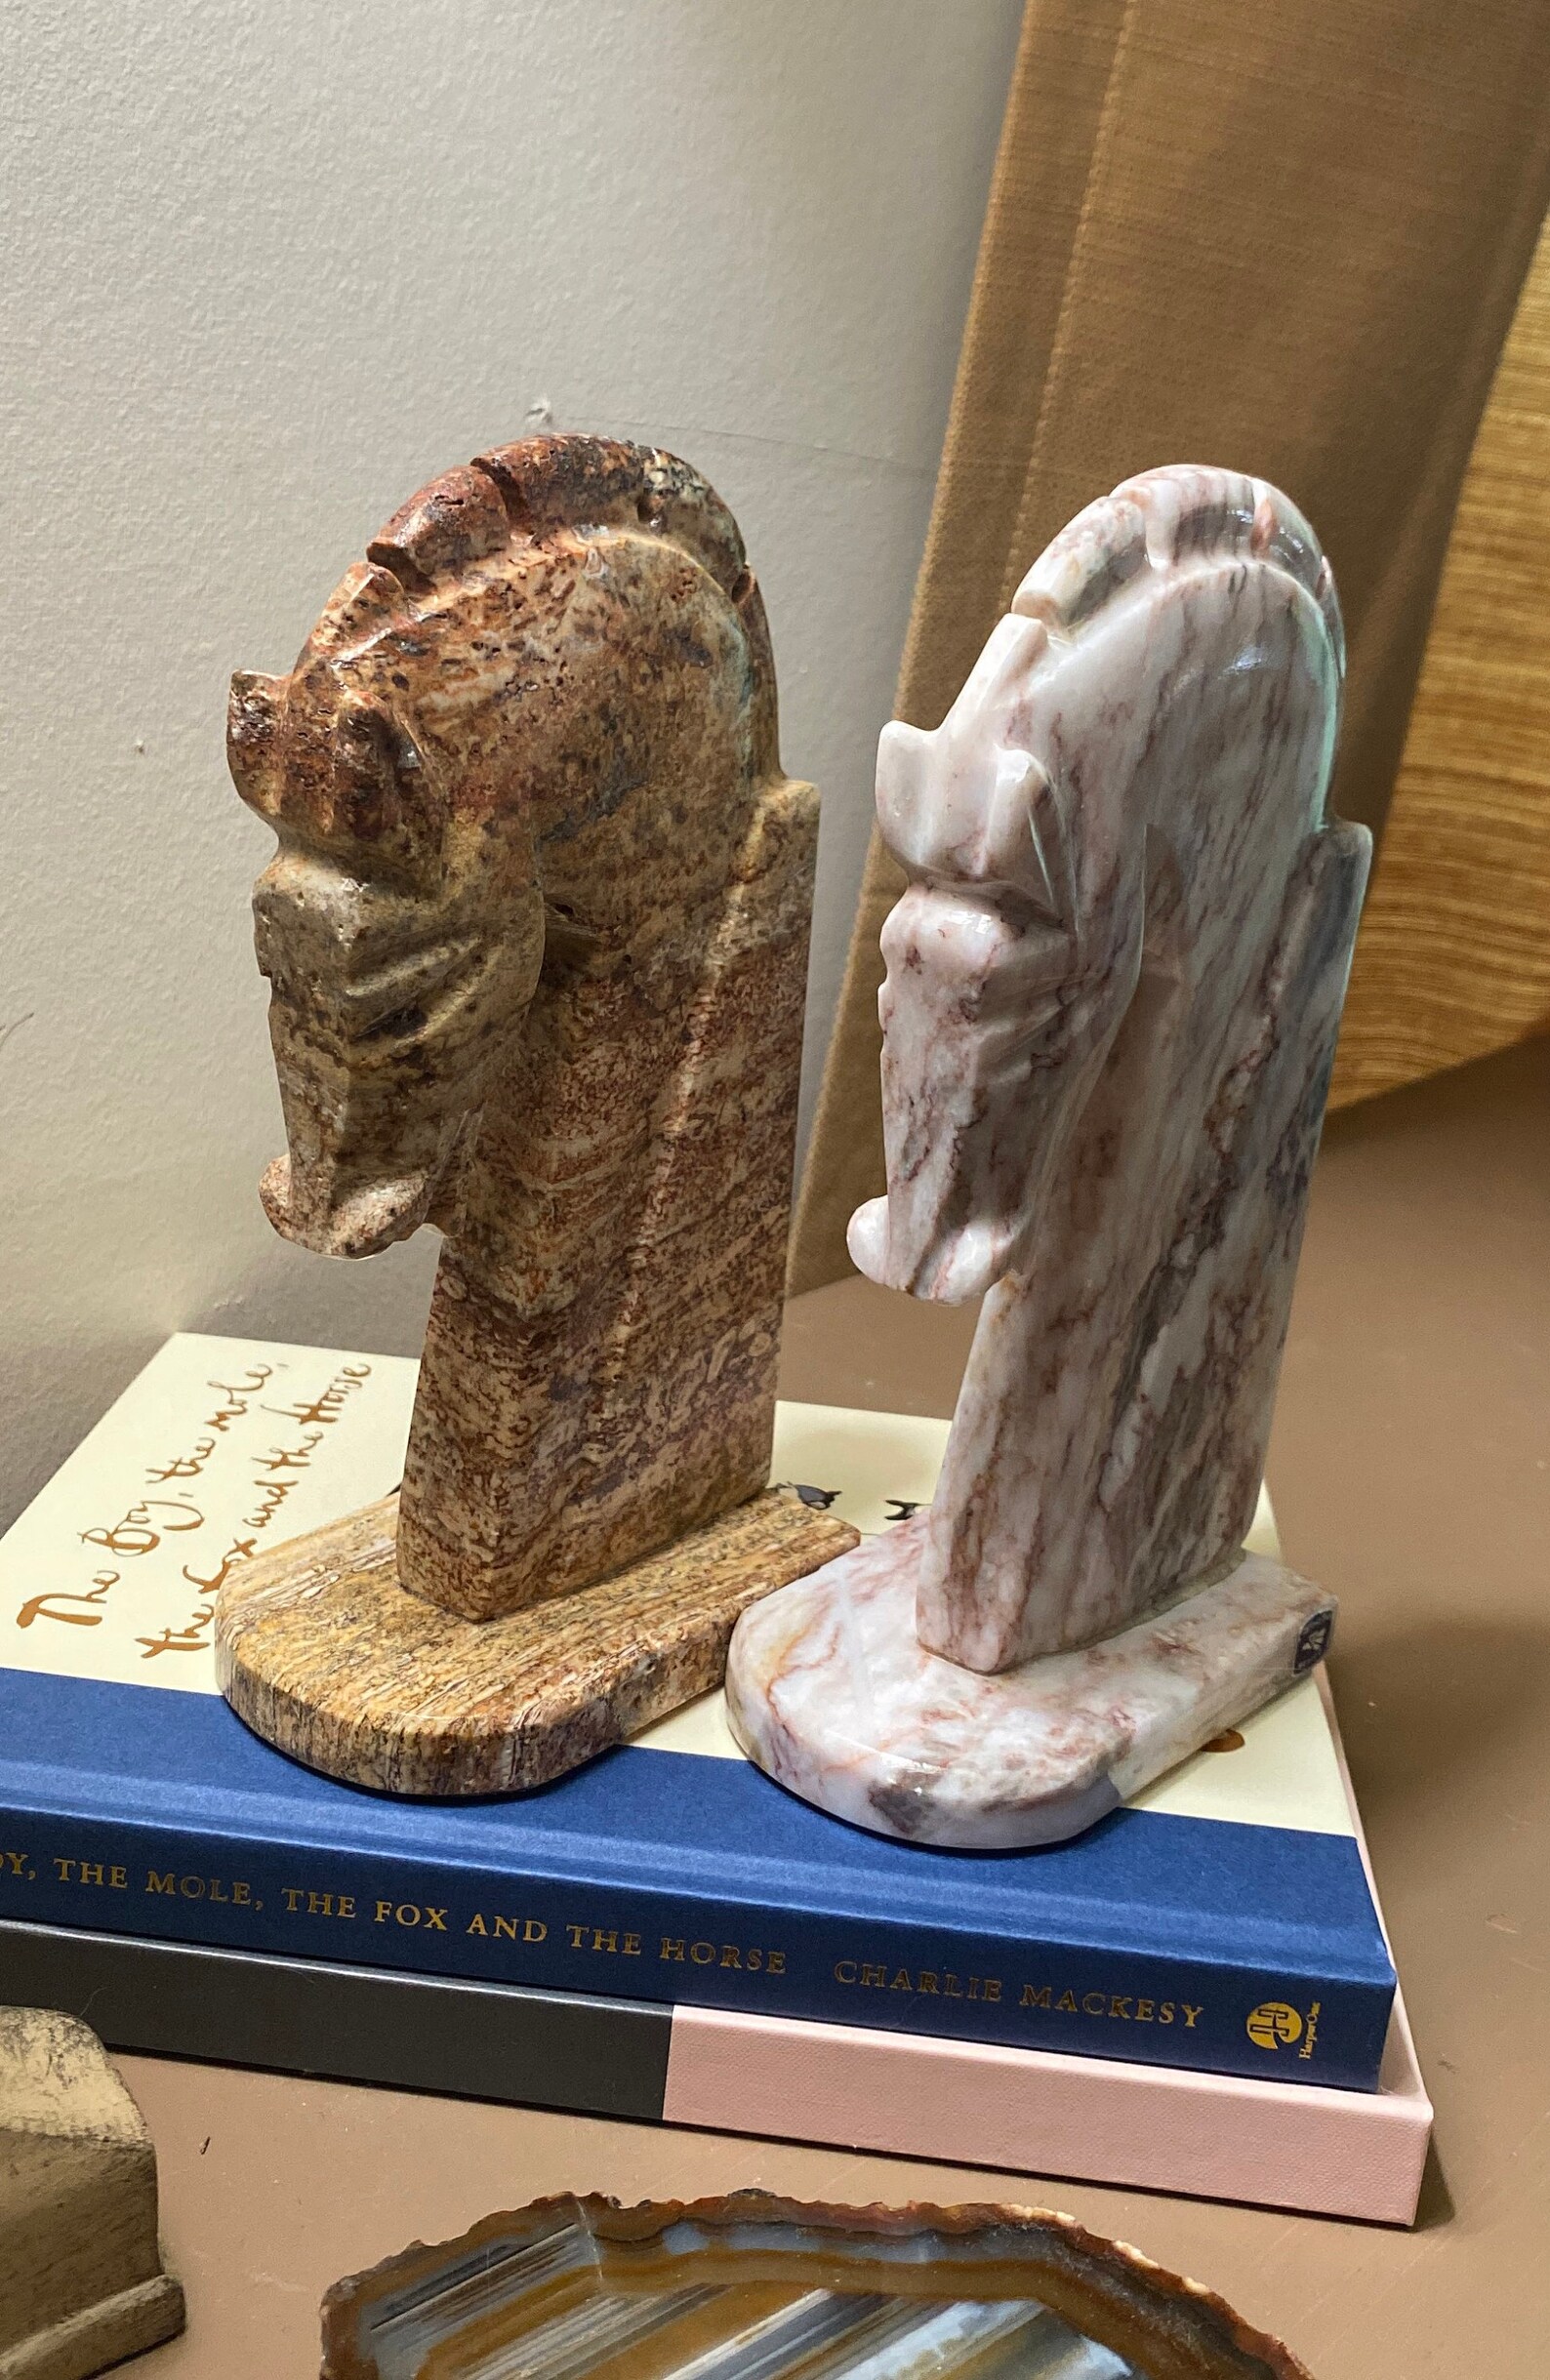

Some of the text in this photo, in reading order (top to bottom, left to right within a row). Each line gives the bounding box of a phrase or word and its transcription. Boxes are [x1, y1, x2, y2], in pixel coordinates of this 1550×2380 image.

[252, 1432, 324, 1471] the
[17, 1569, 121, 1629] The
[146, 1437, 216, 1484] the
[243, 1480, 299, 1527] and
[135, 1603, 215, 1659] the
[0, 1852, 787, 1975] Y, THE MOLE, THE FOX AND THE HORSE
[834, 1960, 1203, 2028] CHARLIE MACKESY
